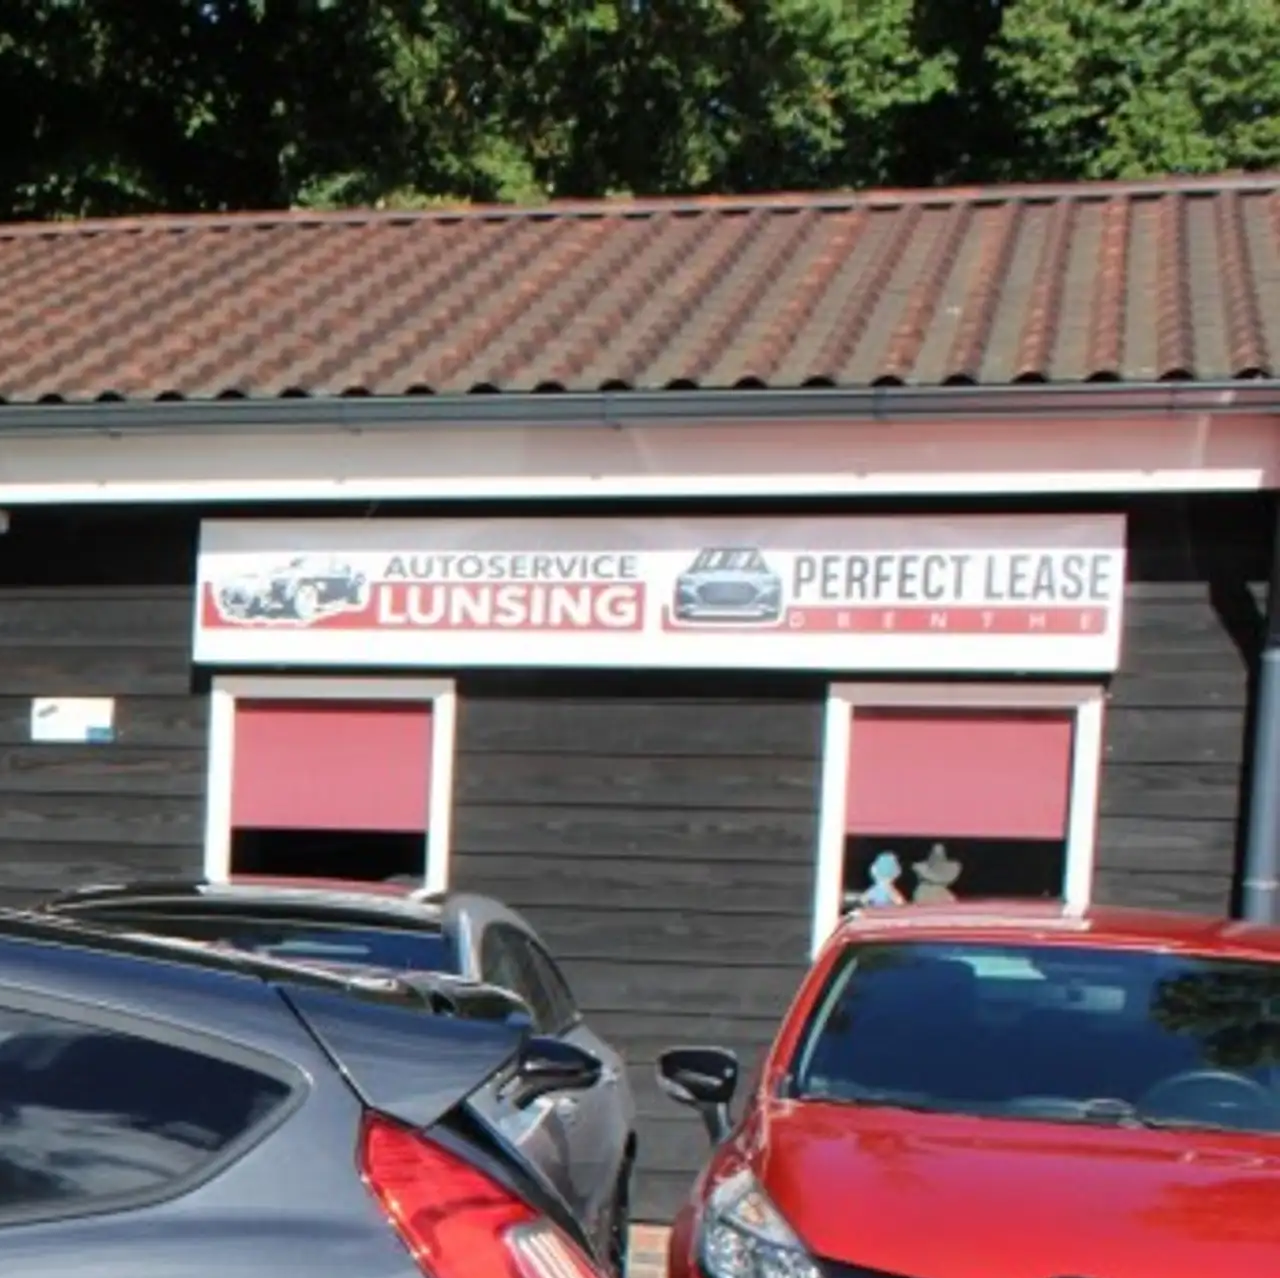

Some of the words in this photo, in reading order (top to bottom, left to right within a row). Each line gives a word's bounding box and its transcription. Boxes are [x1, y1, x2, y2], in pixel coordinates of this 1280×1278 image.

[383, 554, 638, 579] AUTOSERVICE
[792, 554, 972, 599] PERFECT
[984, 555, 1111, 600] LEASE
[378, 584, 638, 628] LUNSING
